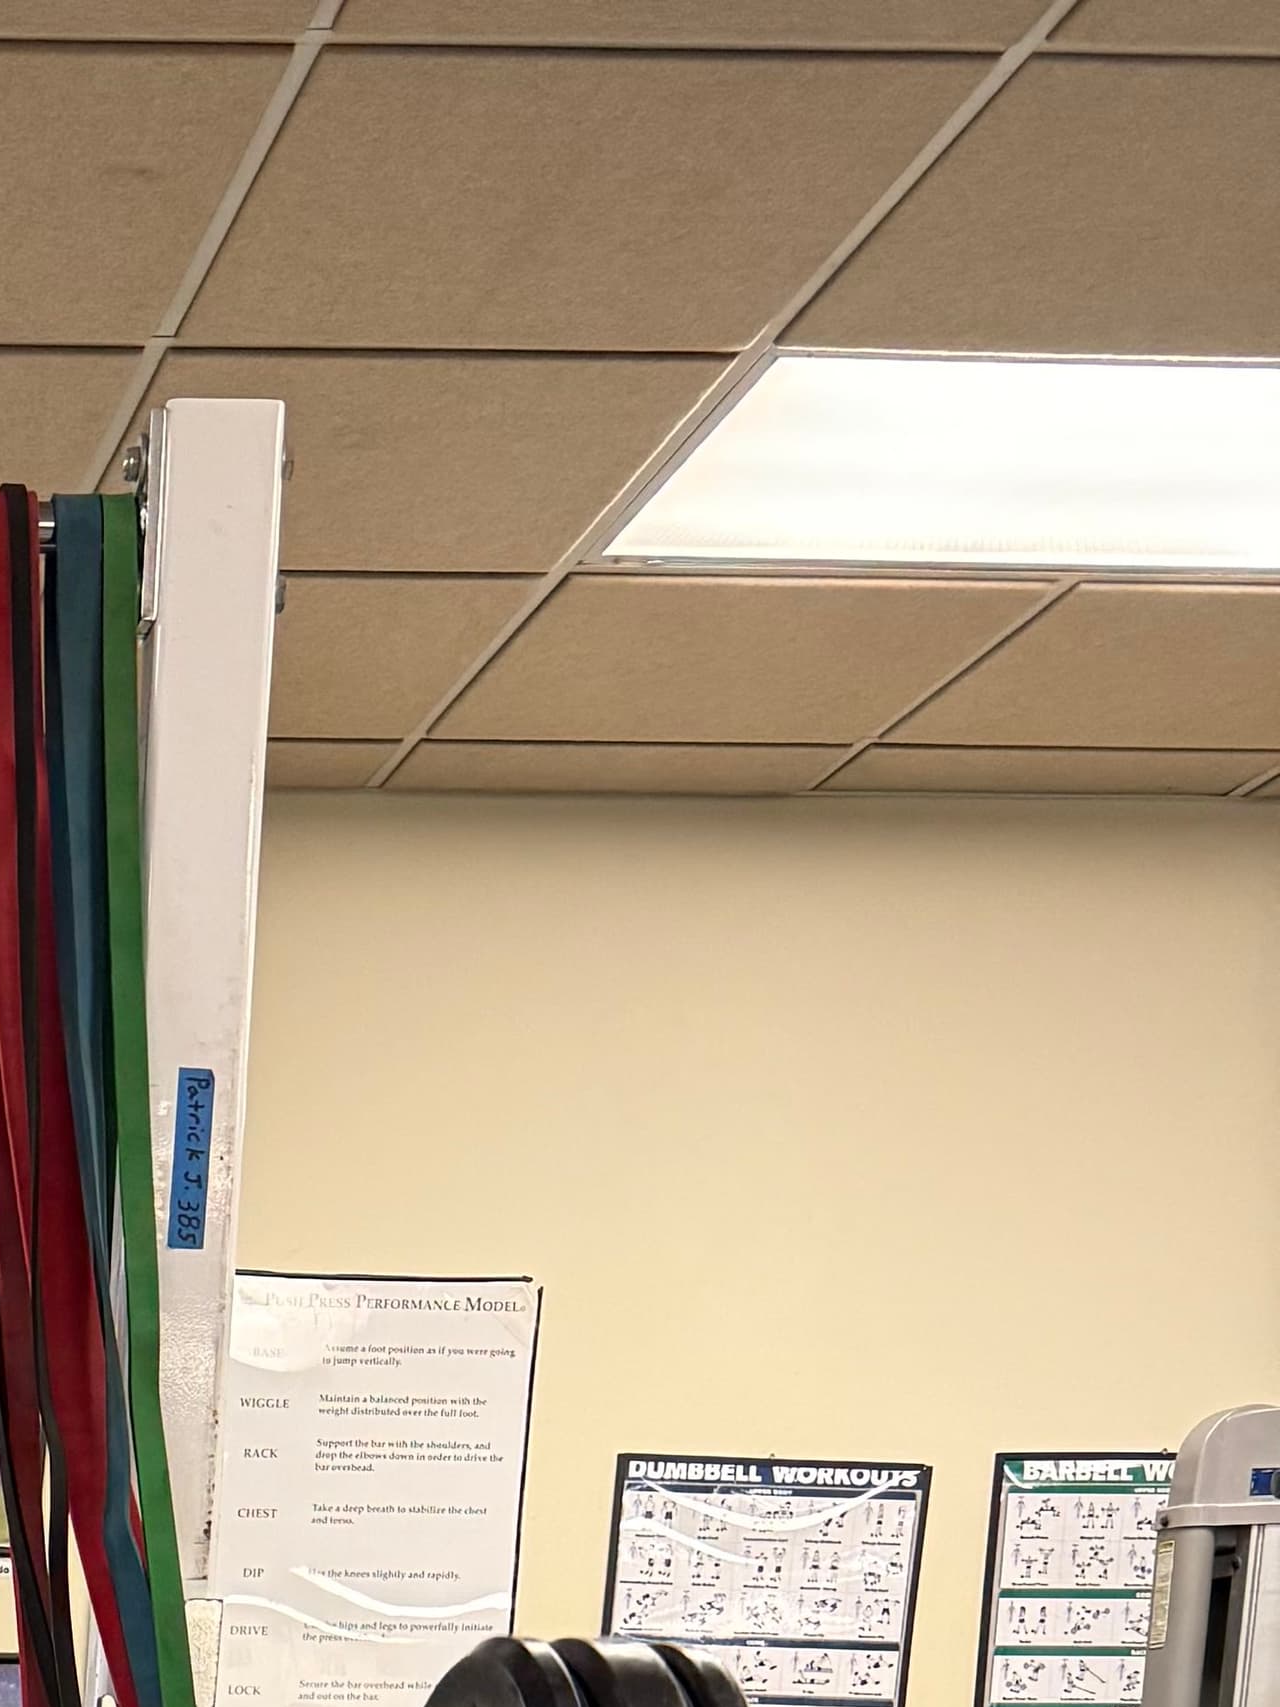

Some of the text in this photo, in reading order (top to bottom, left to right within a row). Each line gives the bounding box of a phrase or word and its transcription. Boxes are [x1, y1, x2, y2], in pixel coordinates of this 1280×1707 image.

[186, 1076, 210, 1161] Patrick
[177, 1199, 201, 1246] 385
[356, 1295, 462, 1311] PERFORMANCE
[465, 1296, 519, 1313] MODEL
[240, 1397, 289, 1408] WIGGLE
[244, 1448, 278, 1459] RACK
[628, 1460, 921, 1487] DUMBBELL WORKOUTS
[237, 1508, 278, 1518] CHEST
[243, 1568, 264, 1578] DIP
[230, 1625, 268, 1636] DRIVE
[228, 1685, 260, 1696] LOCK
